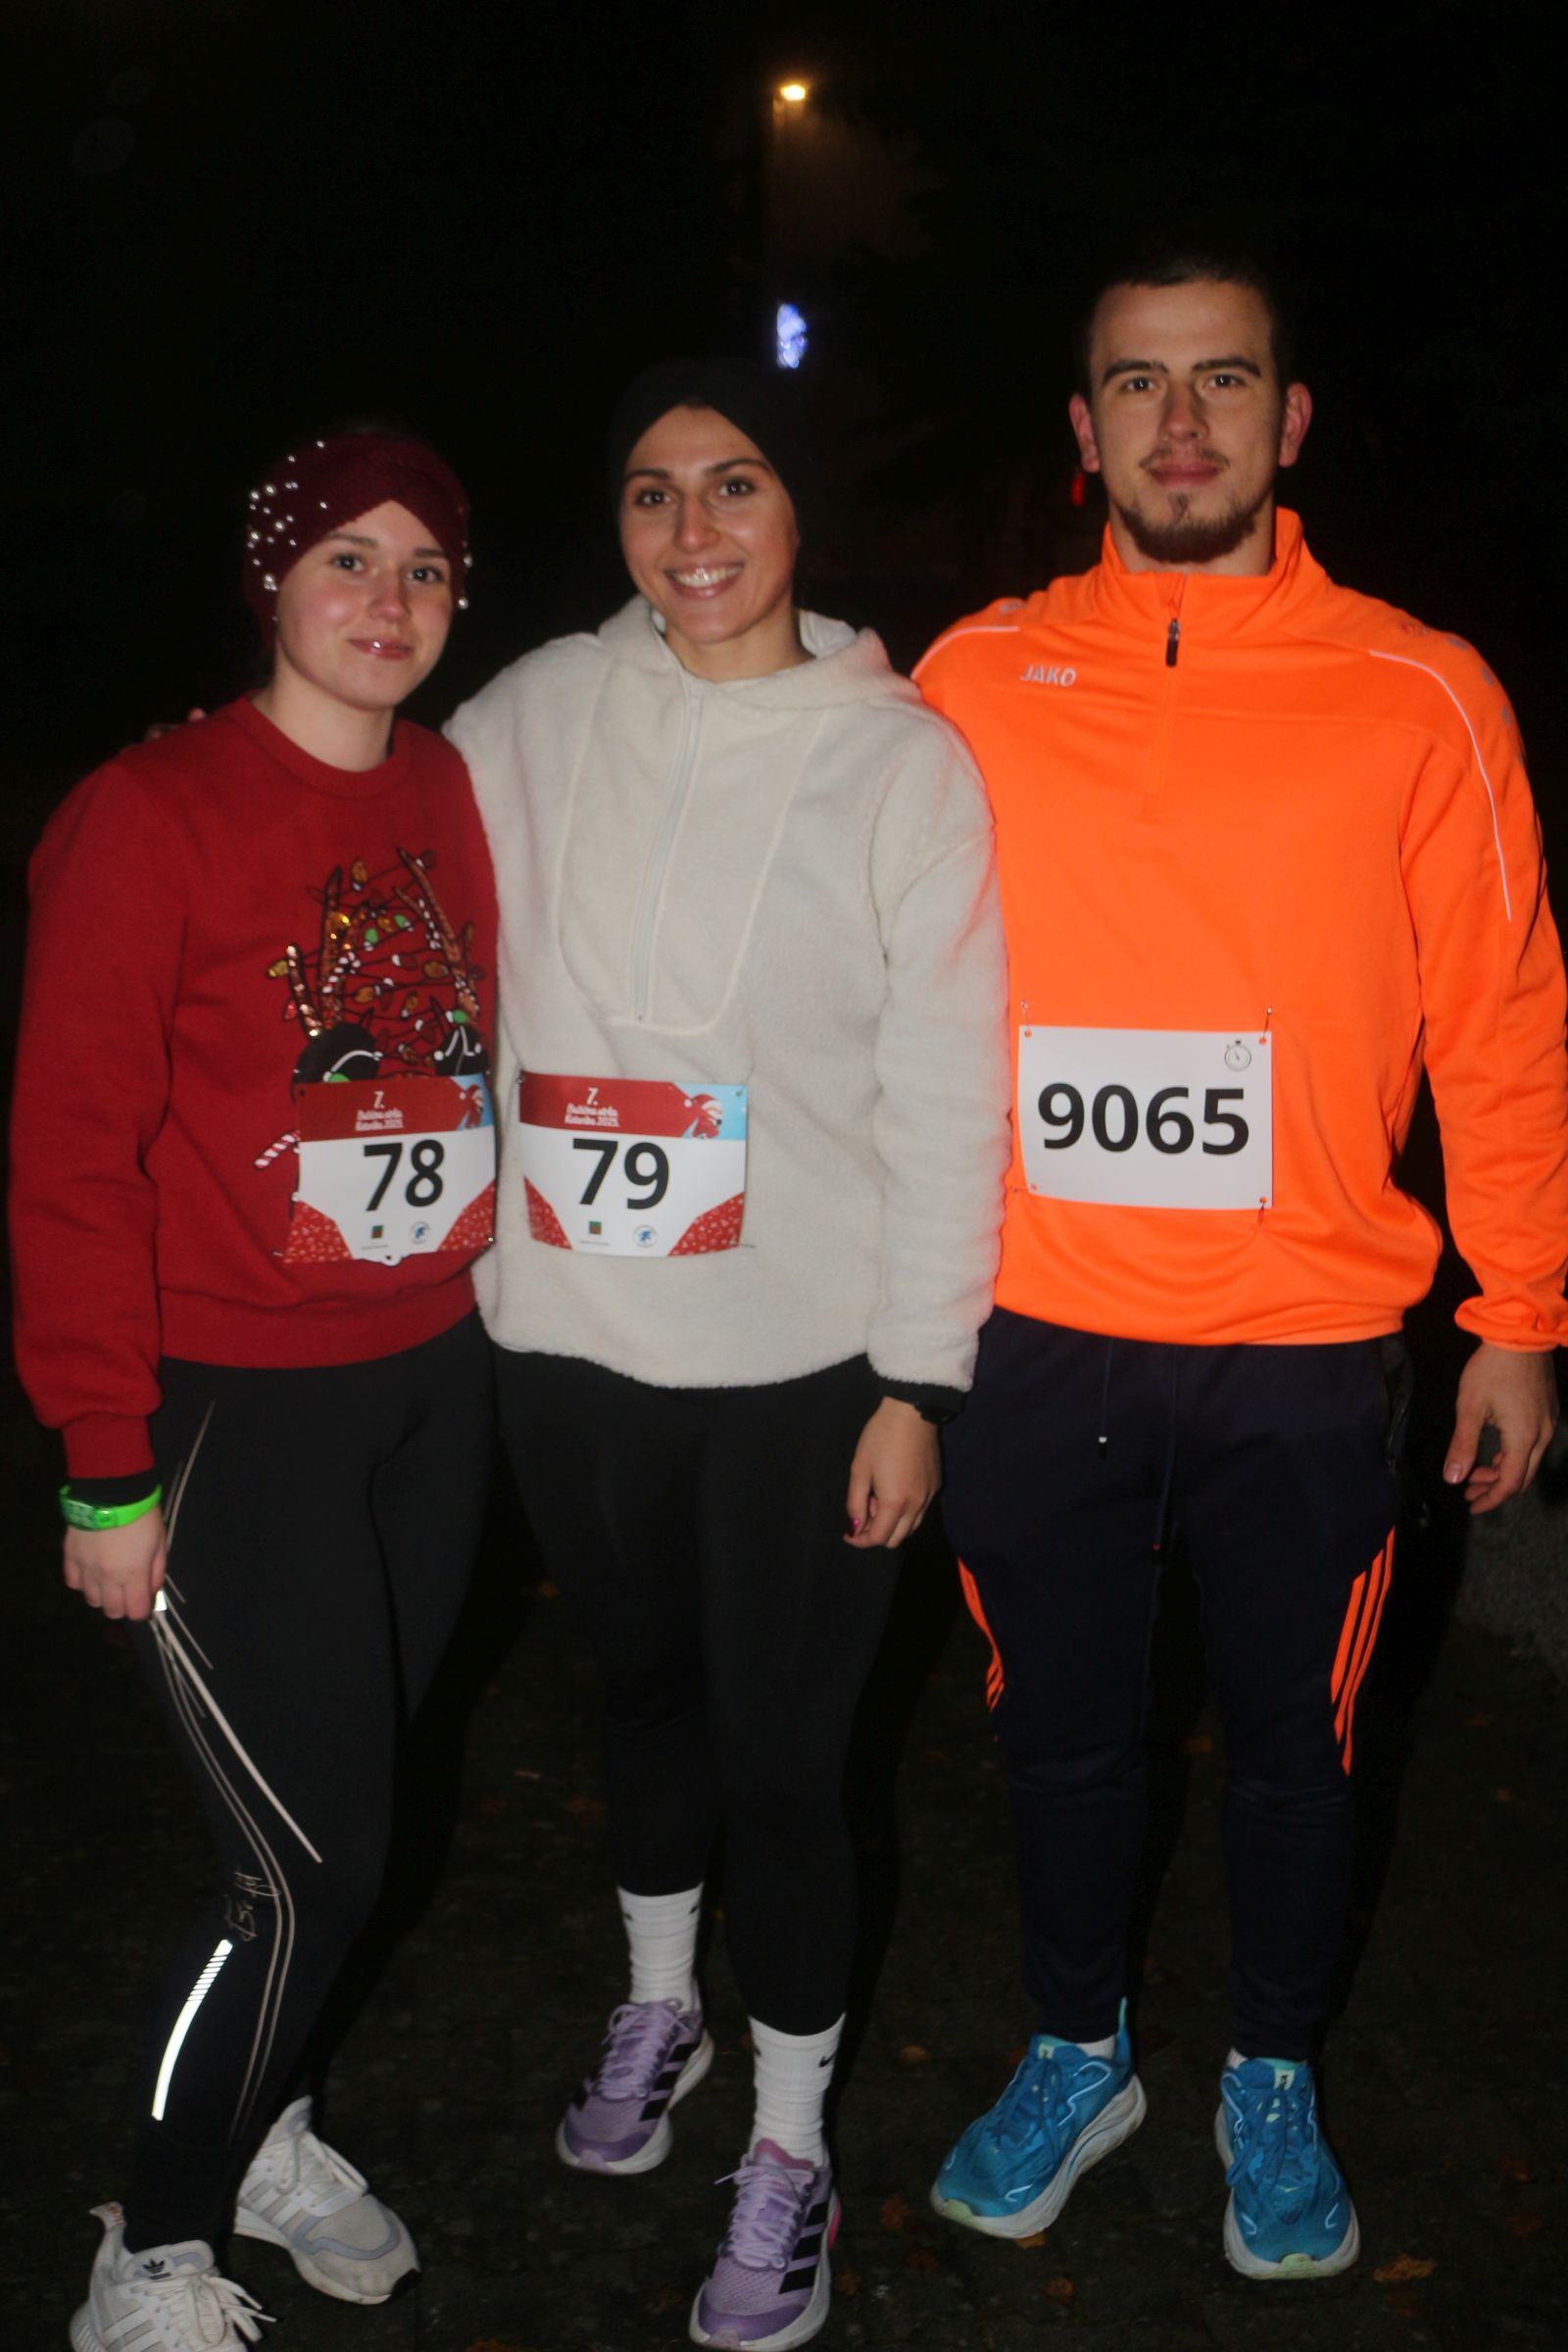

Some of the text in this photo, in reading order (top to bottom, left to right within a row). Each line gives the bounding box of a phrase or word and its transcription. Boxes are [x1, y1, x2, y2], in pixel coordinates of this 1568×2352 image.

[1019, 663, 1077, 687] JAKO
[1038, 1082, 1250, 1155] 9065
[364, 1139, 445, 1211] 78
[572, 1138, 669, 1209] 79
